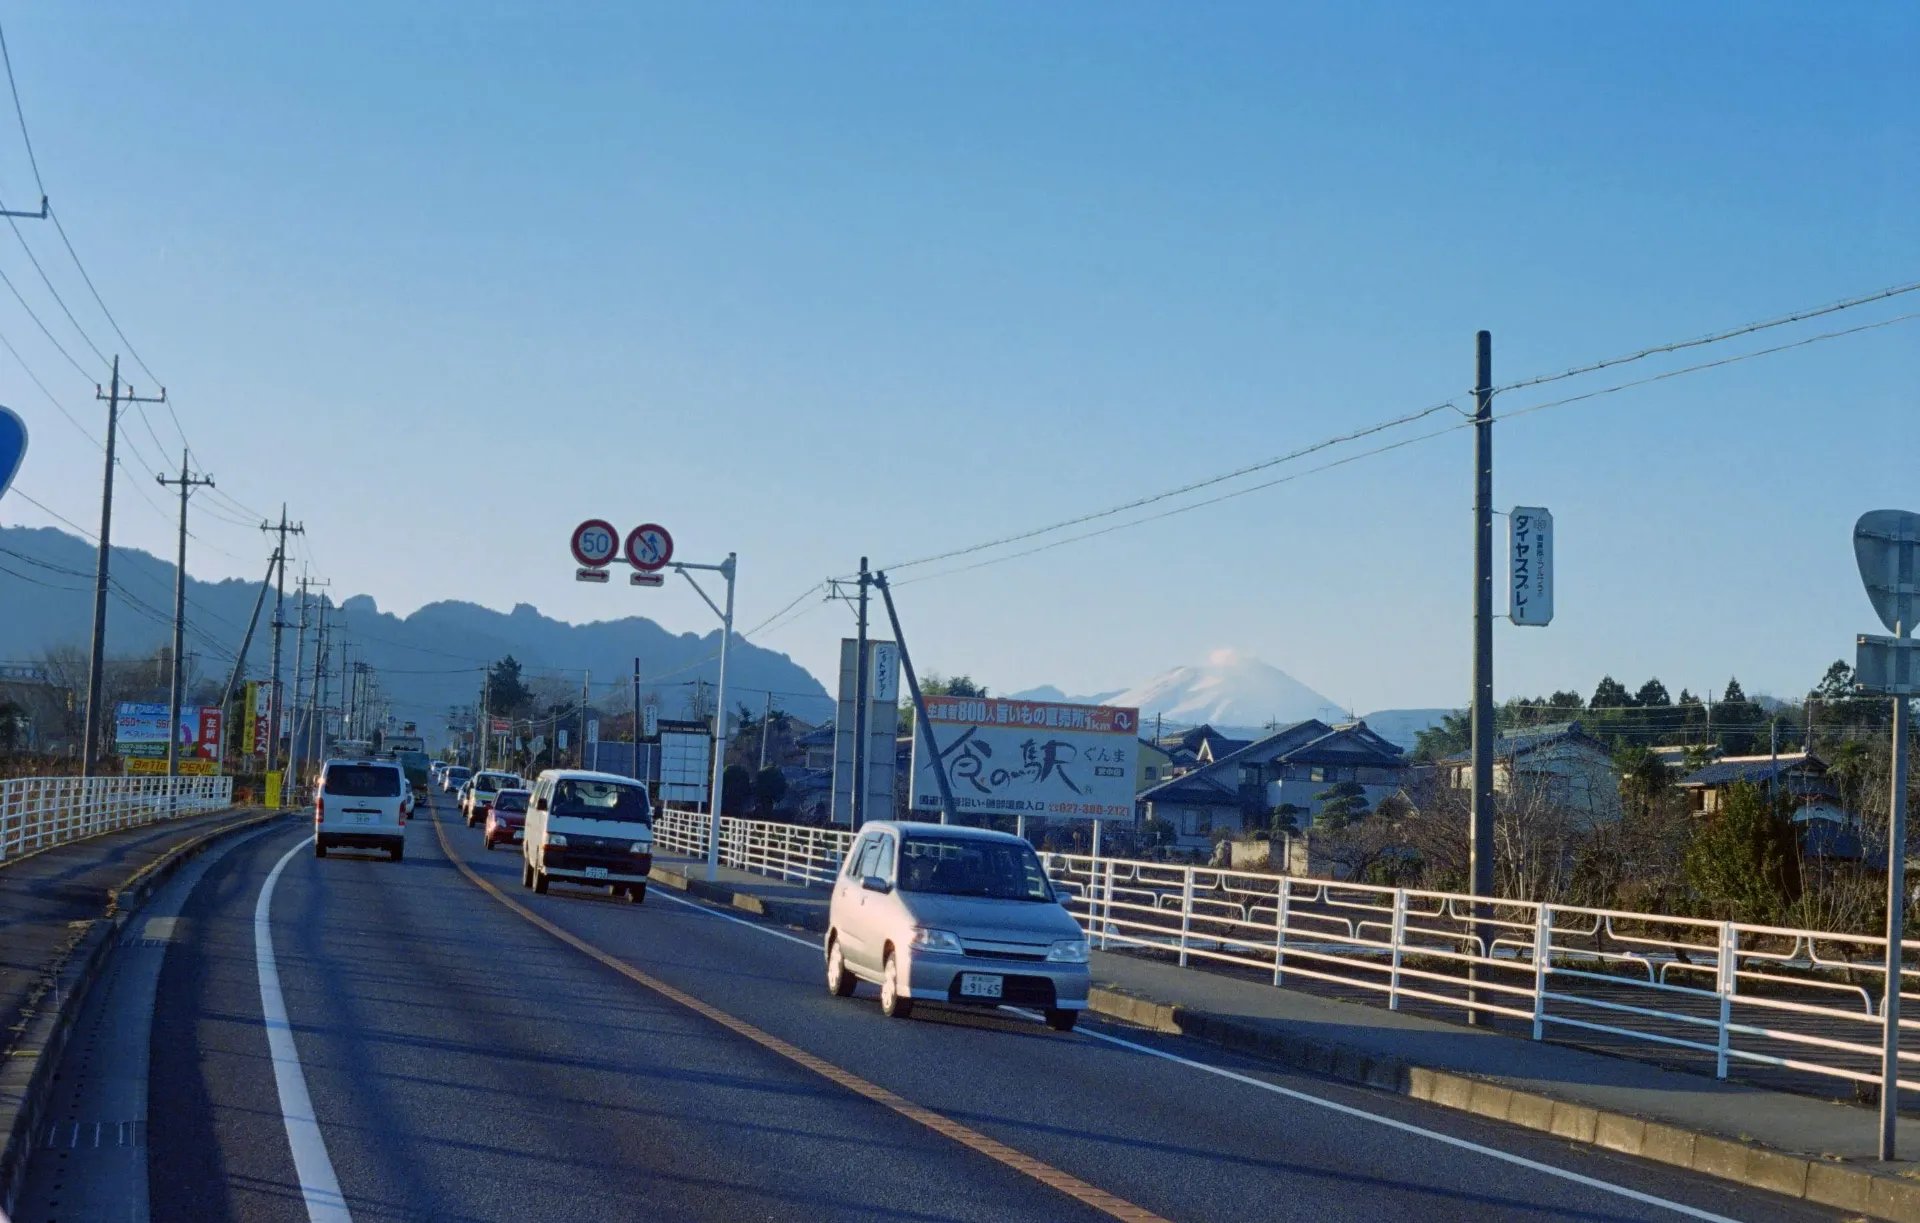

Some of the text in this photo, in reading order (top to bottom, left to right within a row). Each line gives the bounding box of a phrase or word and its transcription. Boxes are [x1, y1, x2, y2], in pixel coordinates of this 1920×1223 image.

[583, 533, 608, 553] 50
[1515, 515, 1533, 618] ダイヤスプレー
[206, 718, 217, 739] 左折
[1084, 746, 1125, 762] ぐんま
[179, 762, 211, 773] PEN!!
